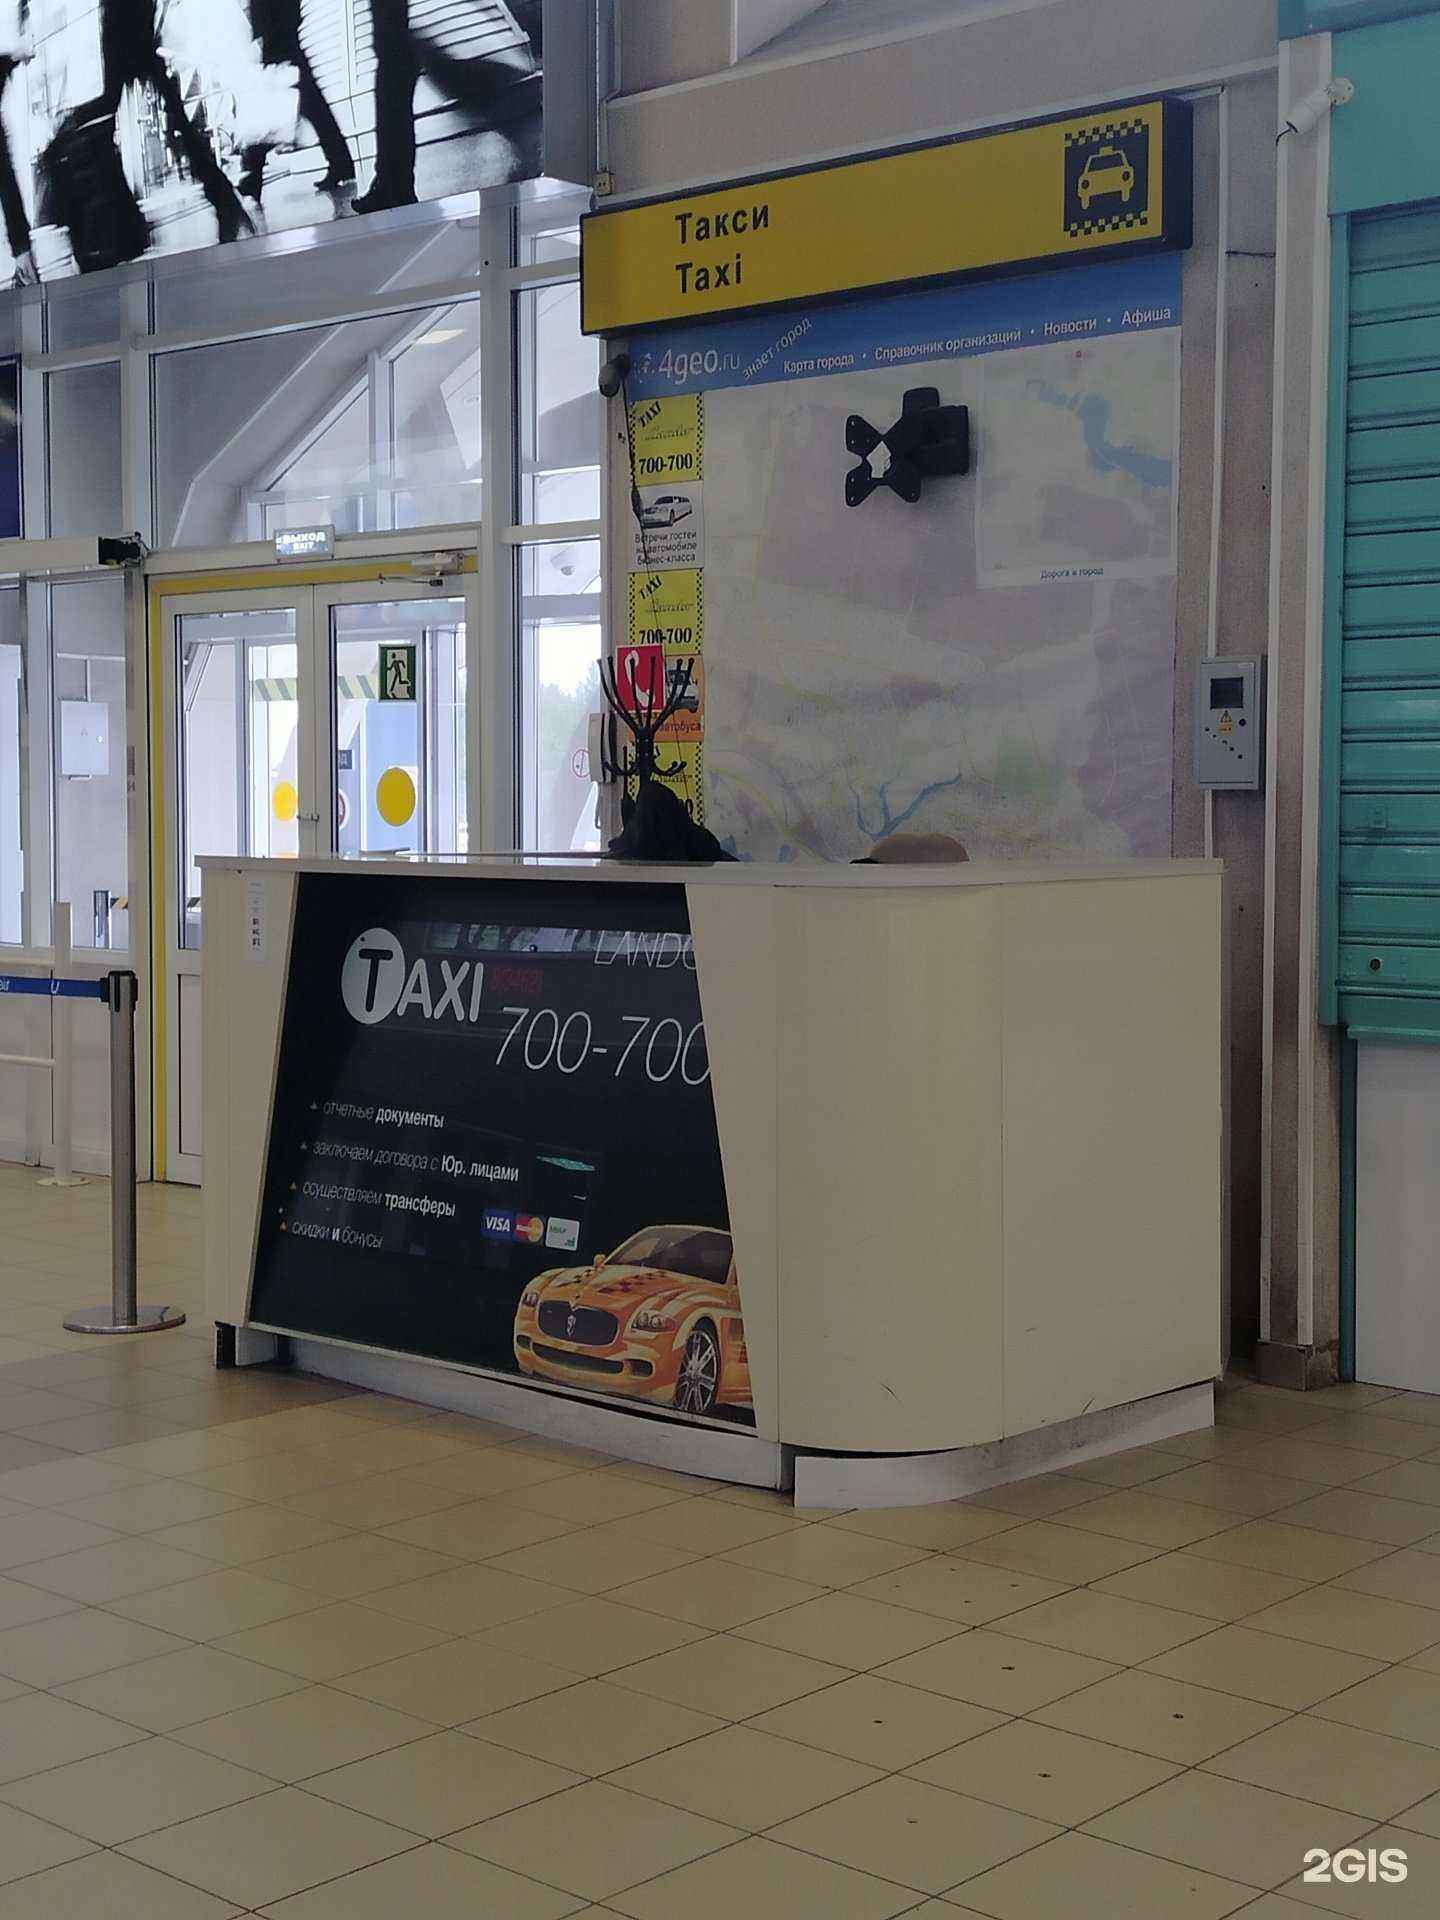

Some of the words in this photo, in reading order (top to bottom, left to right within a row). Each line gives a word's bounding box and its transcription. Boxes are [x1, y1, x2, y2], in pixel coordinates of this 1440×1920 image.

[675, 203, 770, 245] Такси
[675, 253, 743, 294] Taxi
[743, 349, 779, 382] знает
[776, 317, 814, 354] город
[783, 358, 814, 376] Карта
[816, 353, 855, 372] города
[875, 342, 944, 362] Справочник
[1044, 316, 1098, 337] Новости
[1121, 306, 1172, 327] Афиша
[659, 348, 740, 385] 4geo.ru
[638, 400, 662, 428] TAXI
[638, 452, 694, 475] 700-700
[638, 627, 693, 645] 700-700
[354, 942, 484, 1023] TAXI
[496, 1006, 711, 1086] 700-700
[323, 1100, 375, 1120] отчетные
[375, 1106, 445, 1129] документы
[312, 1141, 374, 1162] заключаем
[374, 1149, 428, 1170] договора
[430, 1157, 438, 1170] с
[441, 1154, 467, 1177] Юр.
[468, 1160, 519, 1183] лицами
[302, 1180, 382, 1205] осуществляем
[384, 1191, 456, 1217] трансферы
[291, 1220, 330, 1241] скидки
[331, 1228, 341, 1241] и
[341, 1226, 384, 1249] бонусы
[485, 1216, 511, 1233] VISA
